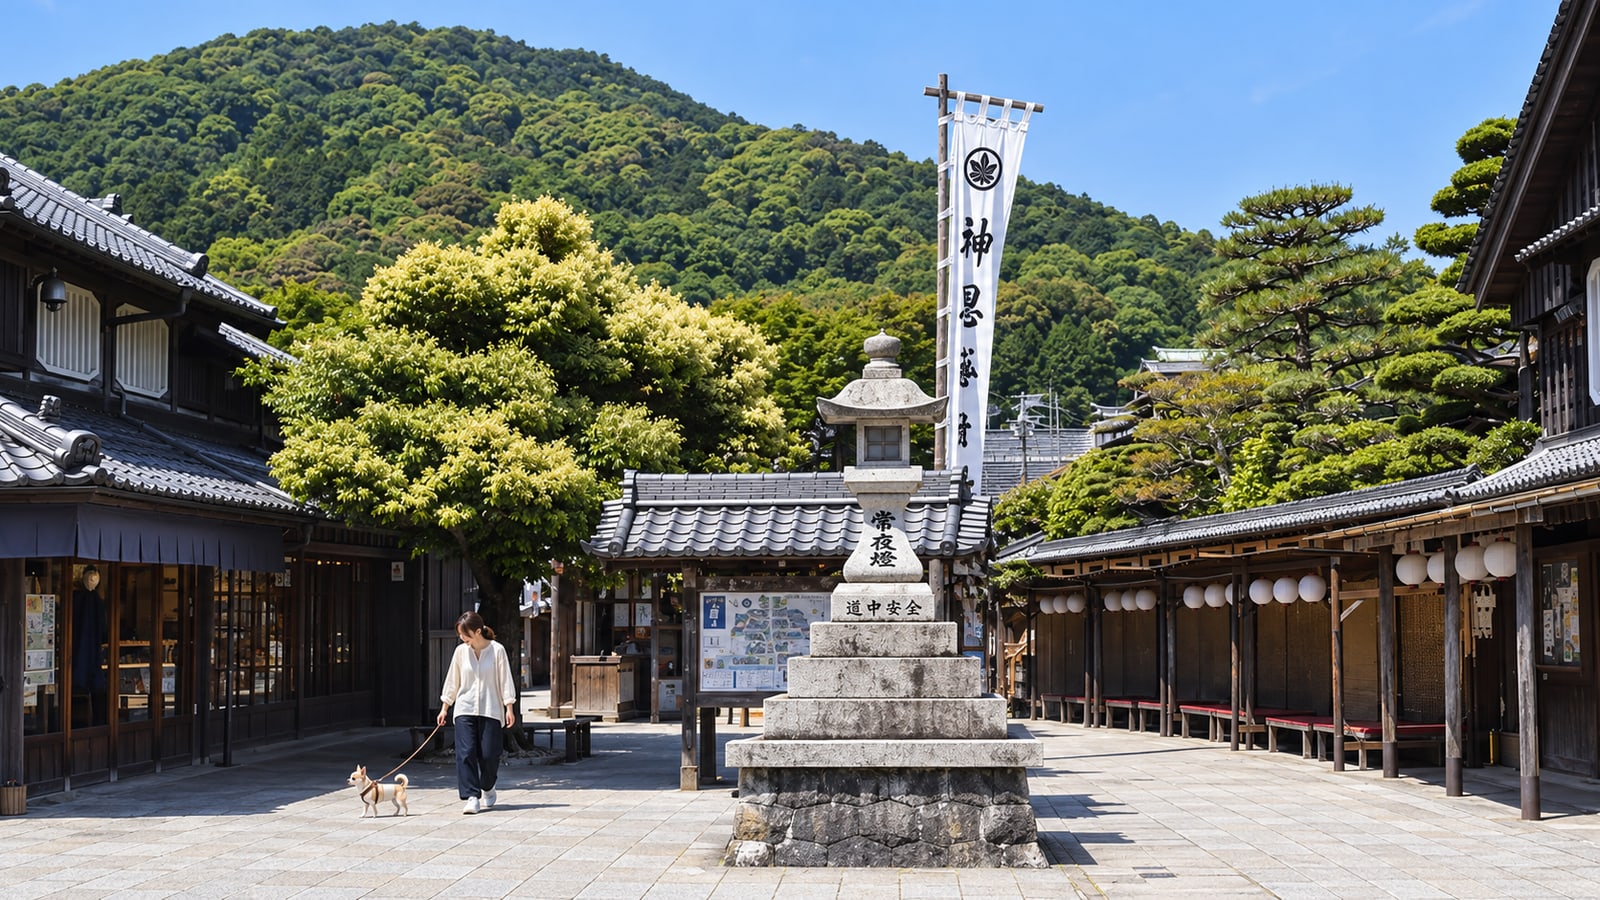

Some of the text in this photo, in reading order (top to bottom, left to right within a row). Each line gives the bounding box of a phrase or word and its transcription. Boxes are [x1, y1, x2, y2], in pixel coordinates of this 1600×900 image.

[870, 510, 898, 568] 常夜燈
[846, 599, 922, 617] 道中安全
